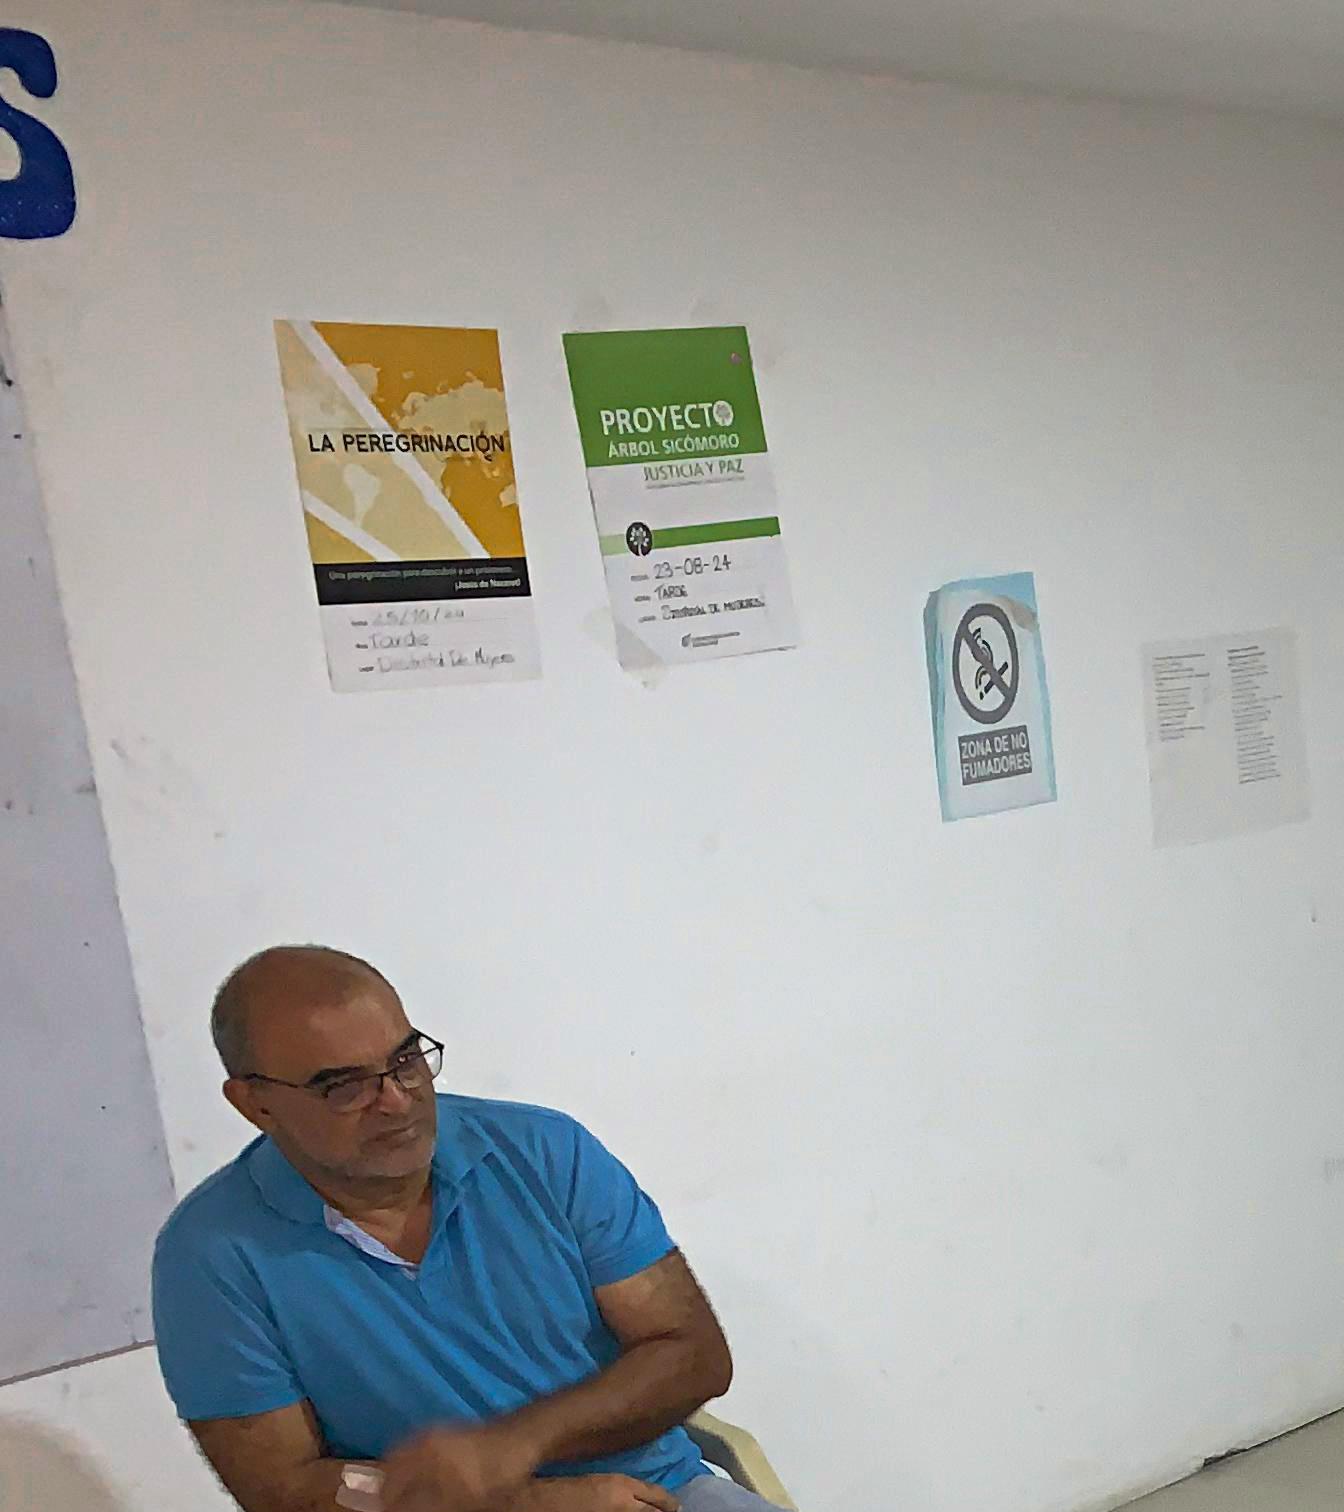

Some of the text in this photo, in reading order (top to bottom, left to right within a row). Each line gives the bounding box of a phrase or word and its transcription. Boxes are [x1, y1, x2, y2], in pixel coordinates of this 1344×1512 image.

[0, 27, 76, 239] S
[600, 400, 734, 436] PROYECTO
[308, 430, 505, 453] LA PEREGRINACIÓN
[608, 433, 740, 459] ÁRBOL SICÓMORO
[643, 458, 745, 482] JUSTICIA Y PAZ
[961, 732, 1027, 759] ZONA DE NO
[962, 752, 1031, 780] FUMADORES
